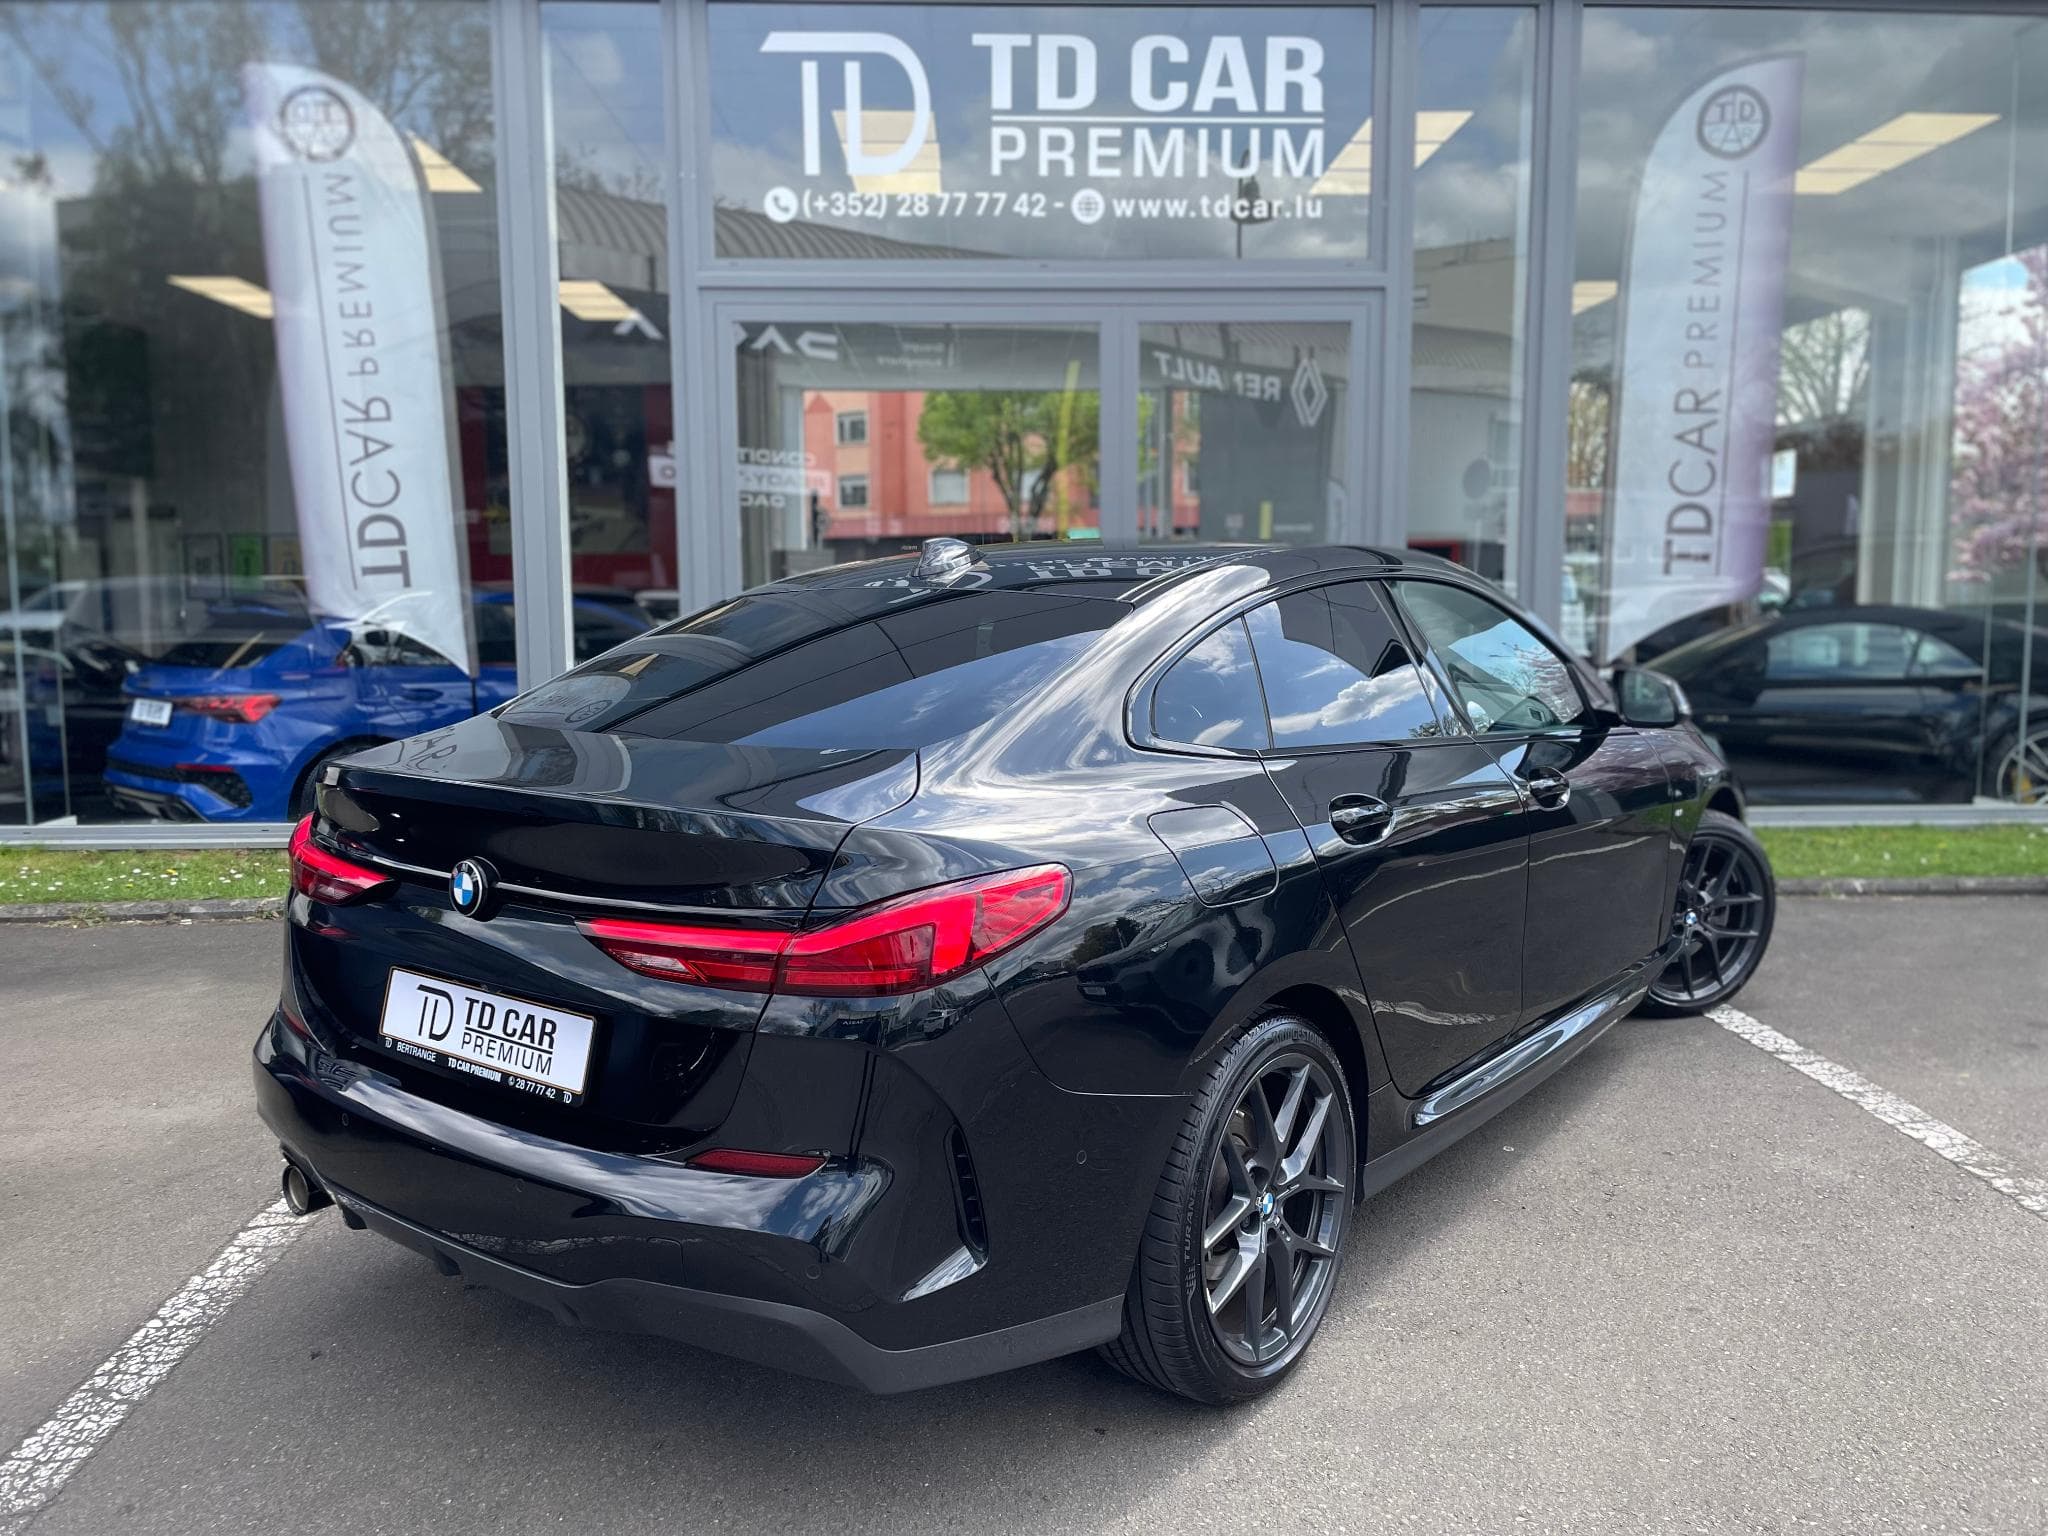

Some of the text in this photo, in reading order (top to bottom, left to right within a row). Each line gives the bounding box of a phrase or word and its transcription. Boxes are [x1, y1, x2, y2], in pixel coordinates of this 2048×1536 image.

[972, 33, 1325, 113] TD CAR
[991, 127, 1325, 178] PREMIUM
[803, 189, 887, 219] (+352)
[896, 192, 930, 217] 28
[936, 192, 971, 217] 77
[975, 192, 1008, 217] 77
[1012, 192, 1046, 217] 42
[1112, 194, 1323, 219] www.tdcar.lu
[1683, 170, 1728, 370] PREMIUM
[464, 997, 557, 1050] TD CAR
[396, 1041, 437, 1063] BERTRANGE
[447, 1057, 457, 1069] TD
[456, 1060, 470, 1073] CAR
[470, 1065, 502, 1083] PREMIUM
[515, 1078, 526, 1090] 28
[526, 1081, 536, 1094] 77
[535, 1085, 546, 1096] 77
[545, 1088, 556, 1099] 42
[461, 1032, 553, 1076] PREMIUM
